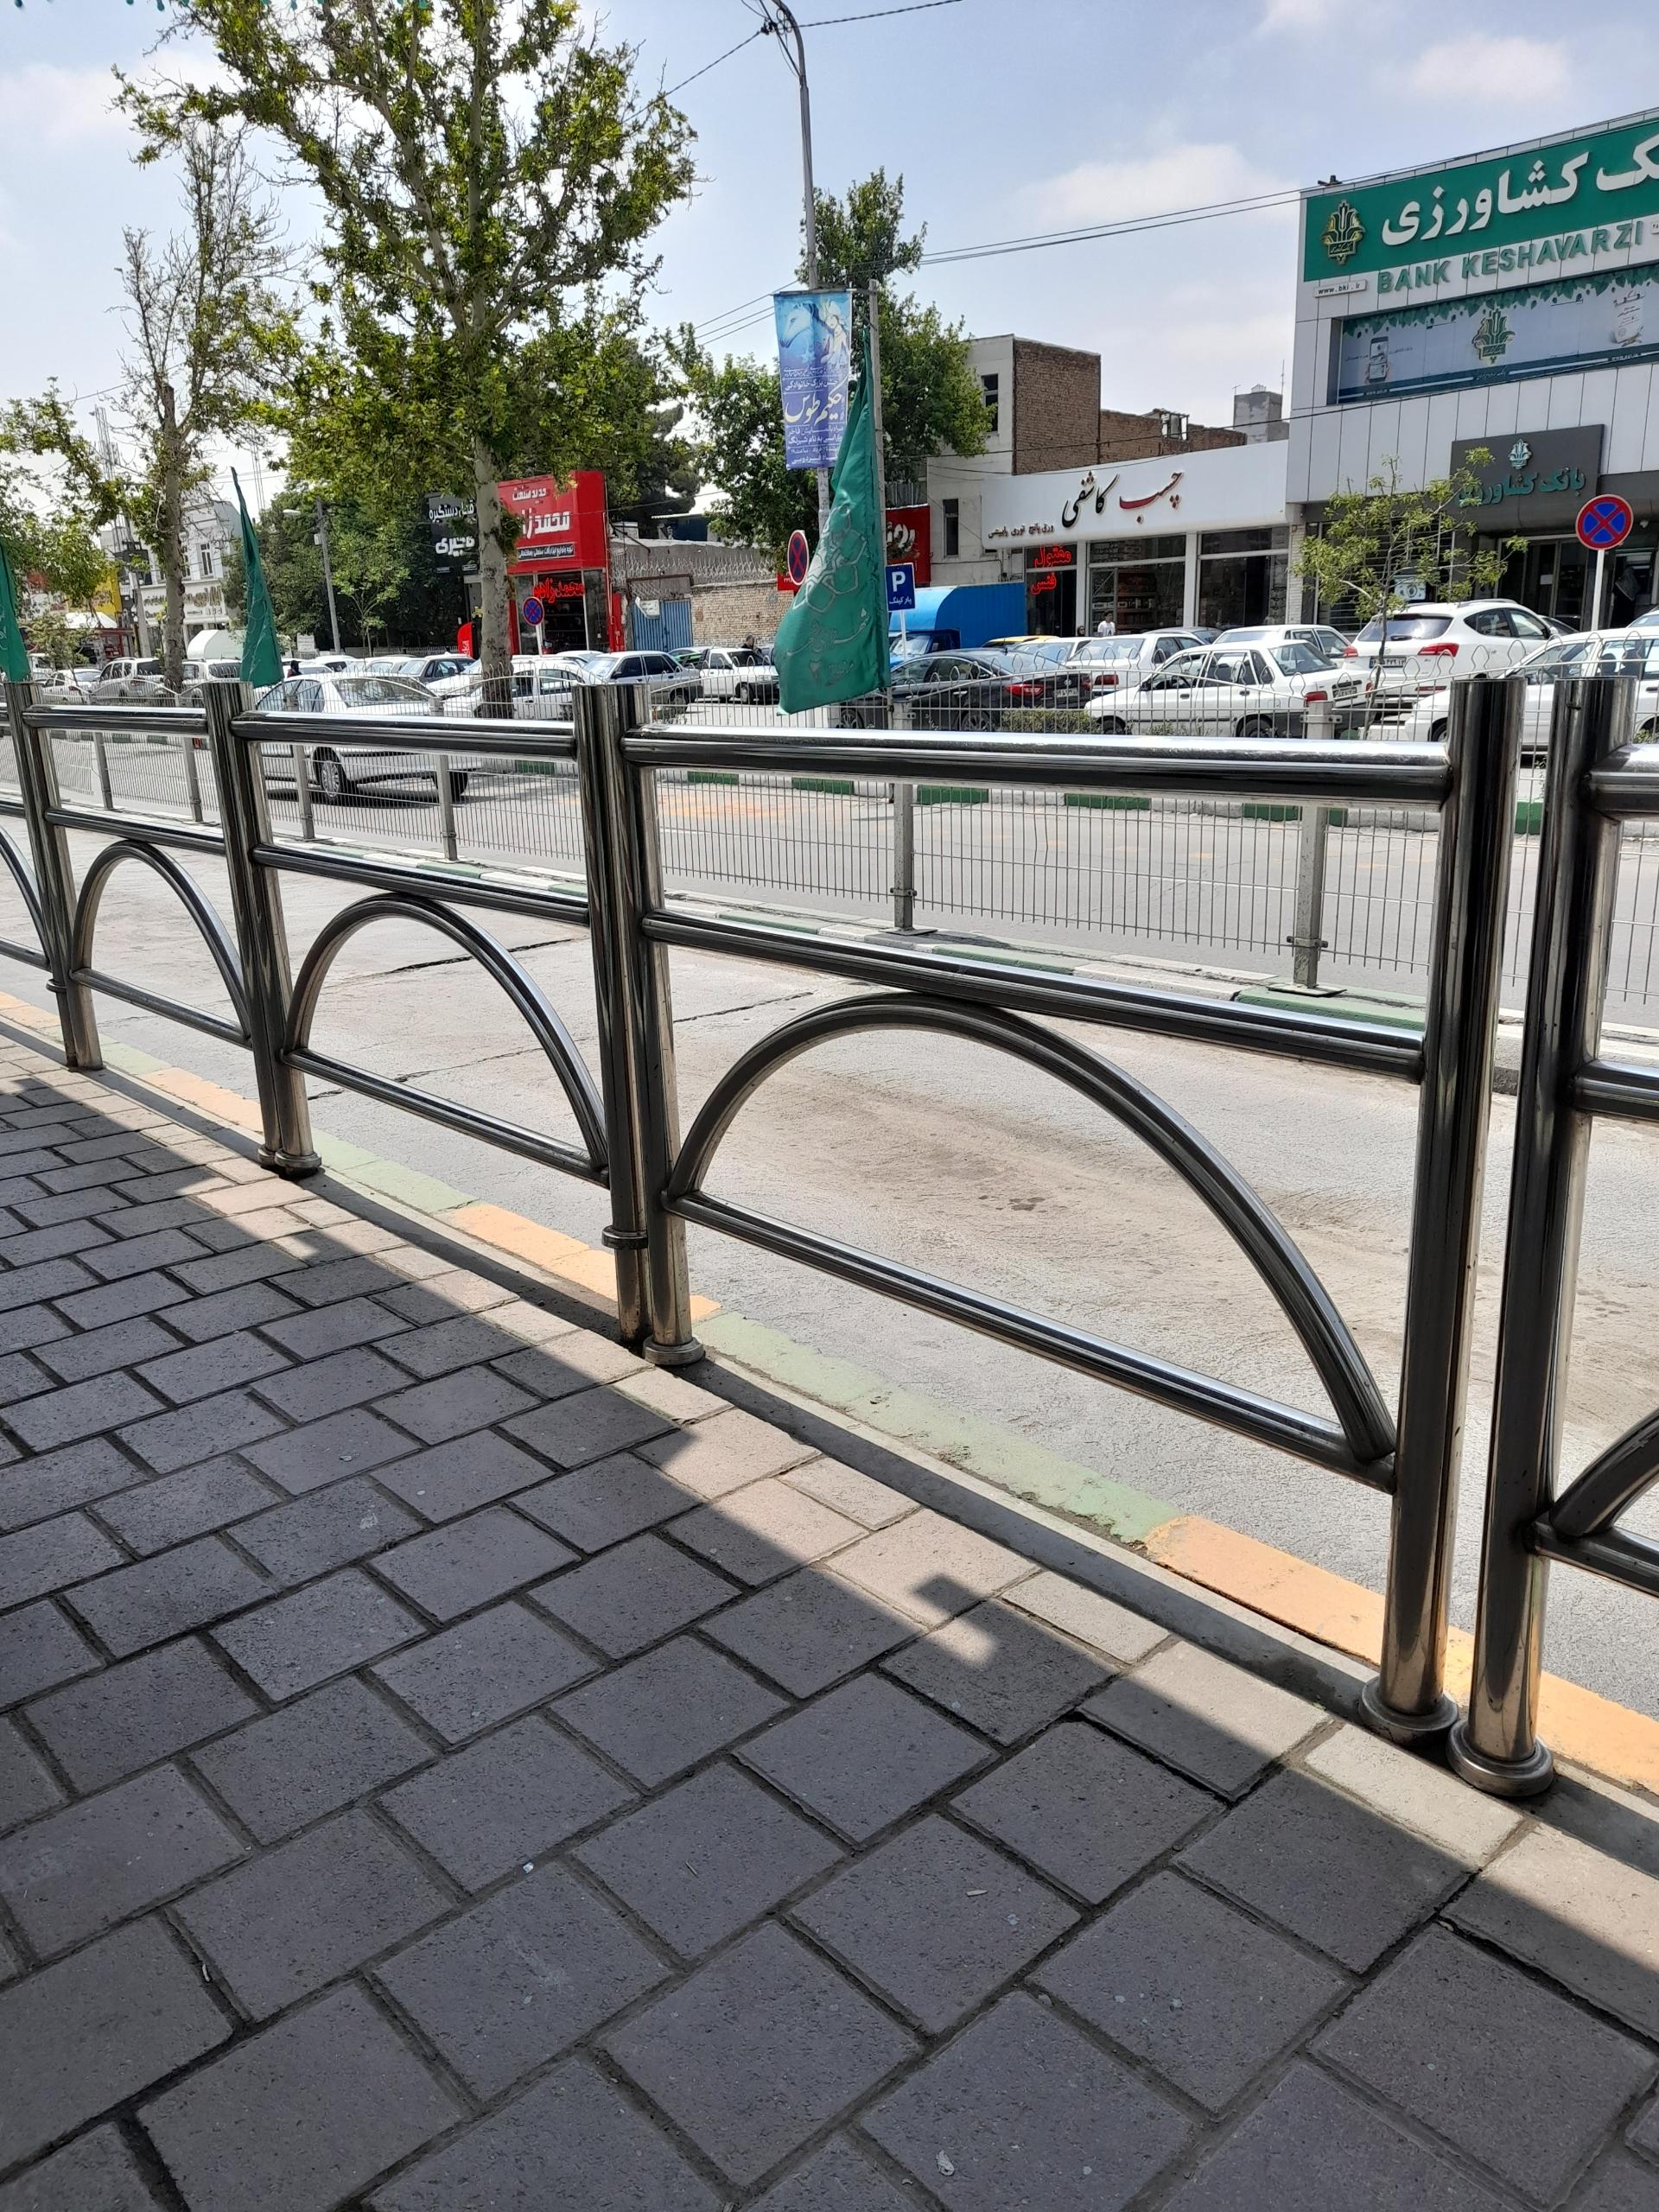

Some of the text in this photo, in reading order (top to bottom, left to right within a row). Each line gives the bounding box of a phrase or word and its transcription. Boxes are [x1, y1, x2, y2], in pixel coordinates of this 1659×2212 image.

[1382, 151, 1590, 246] کشاورزی
[1377, 220, 1643, 295] BANK KESHAVARZI
[785, 391, 821, 424] طوس
[1539, 466, 1586, 497] بانک
[429, 504, 458, 523] دستگیره
[892, 570, 906, 592] P
[889, 595, 912, 605] پارکینگ
